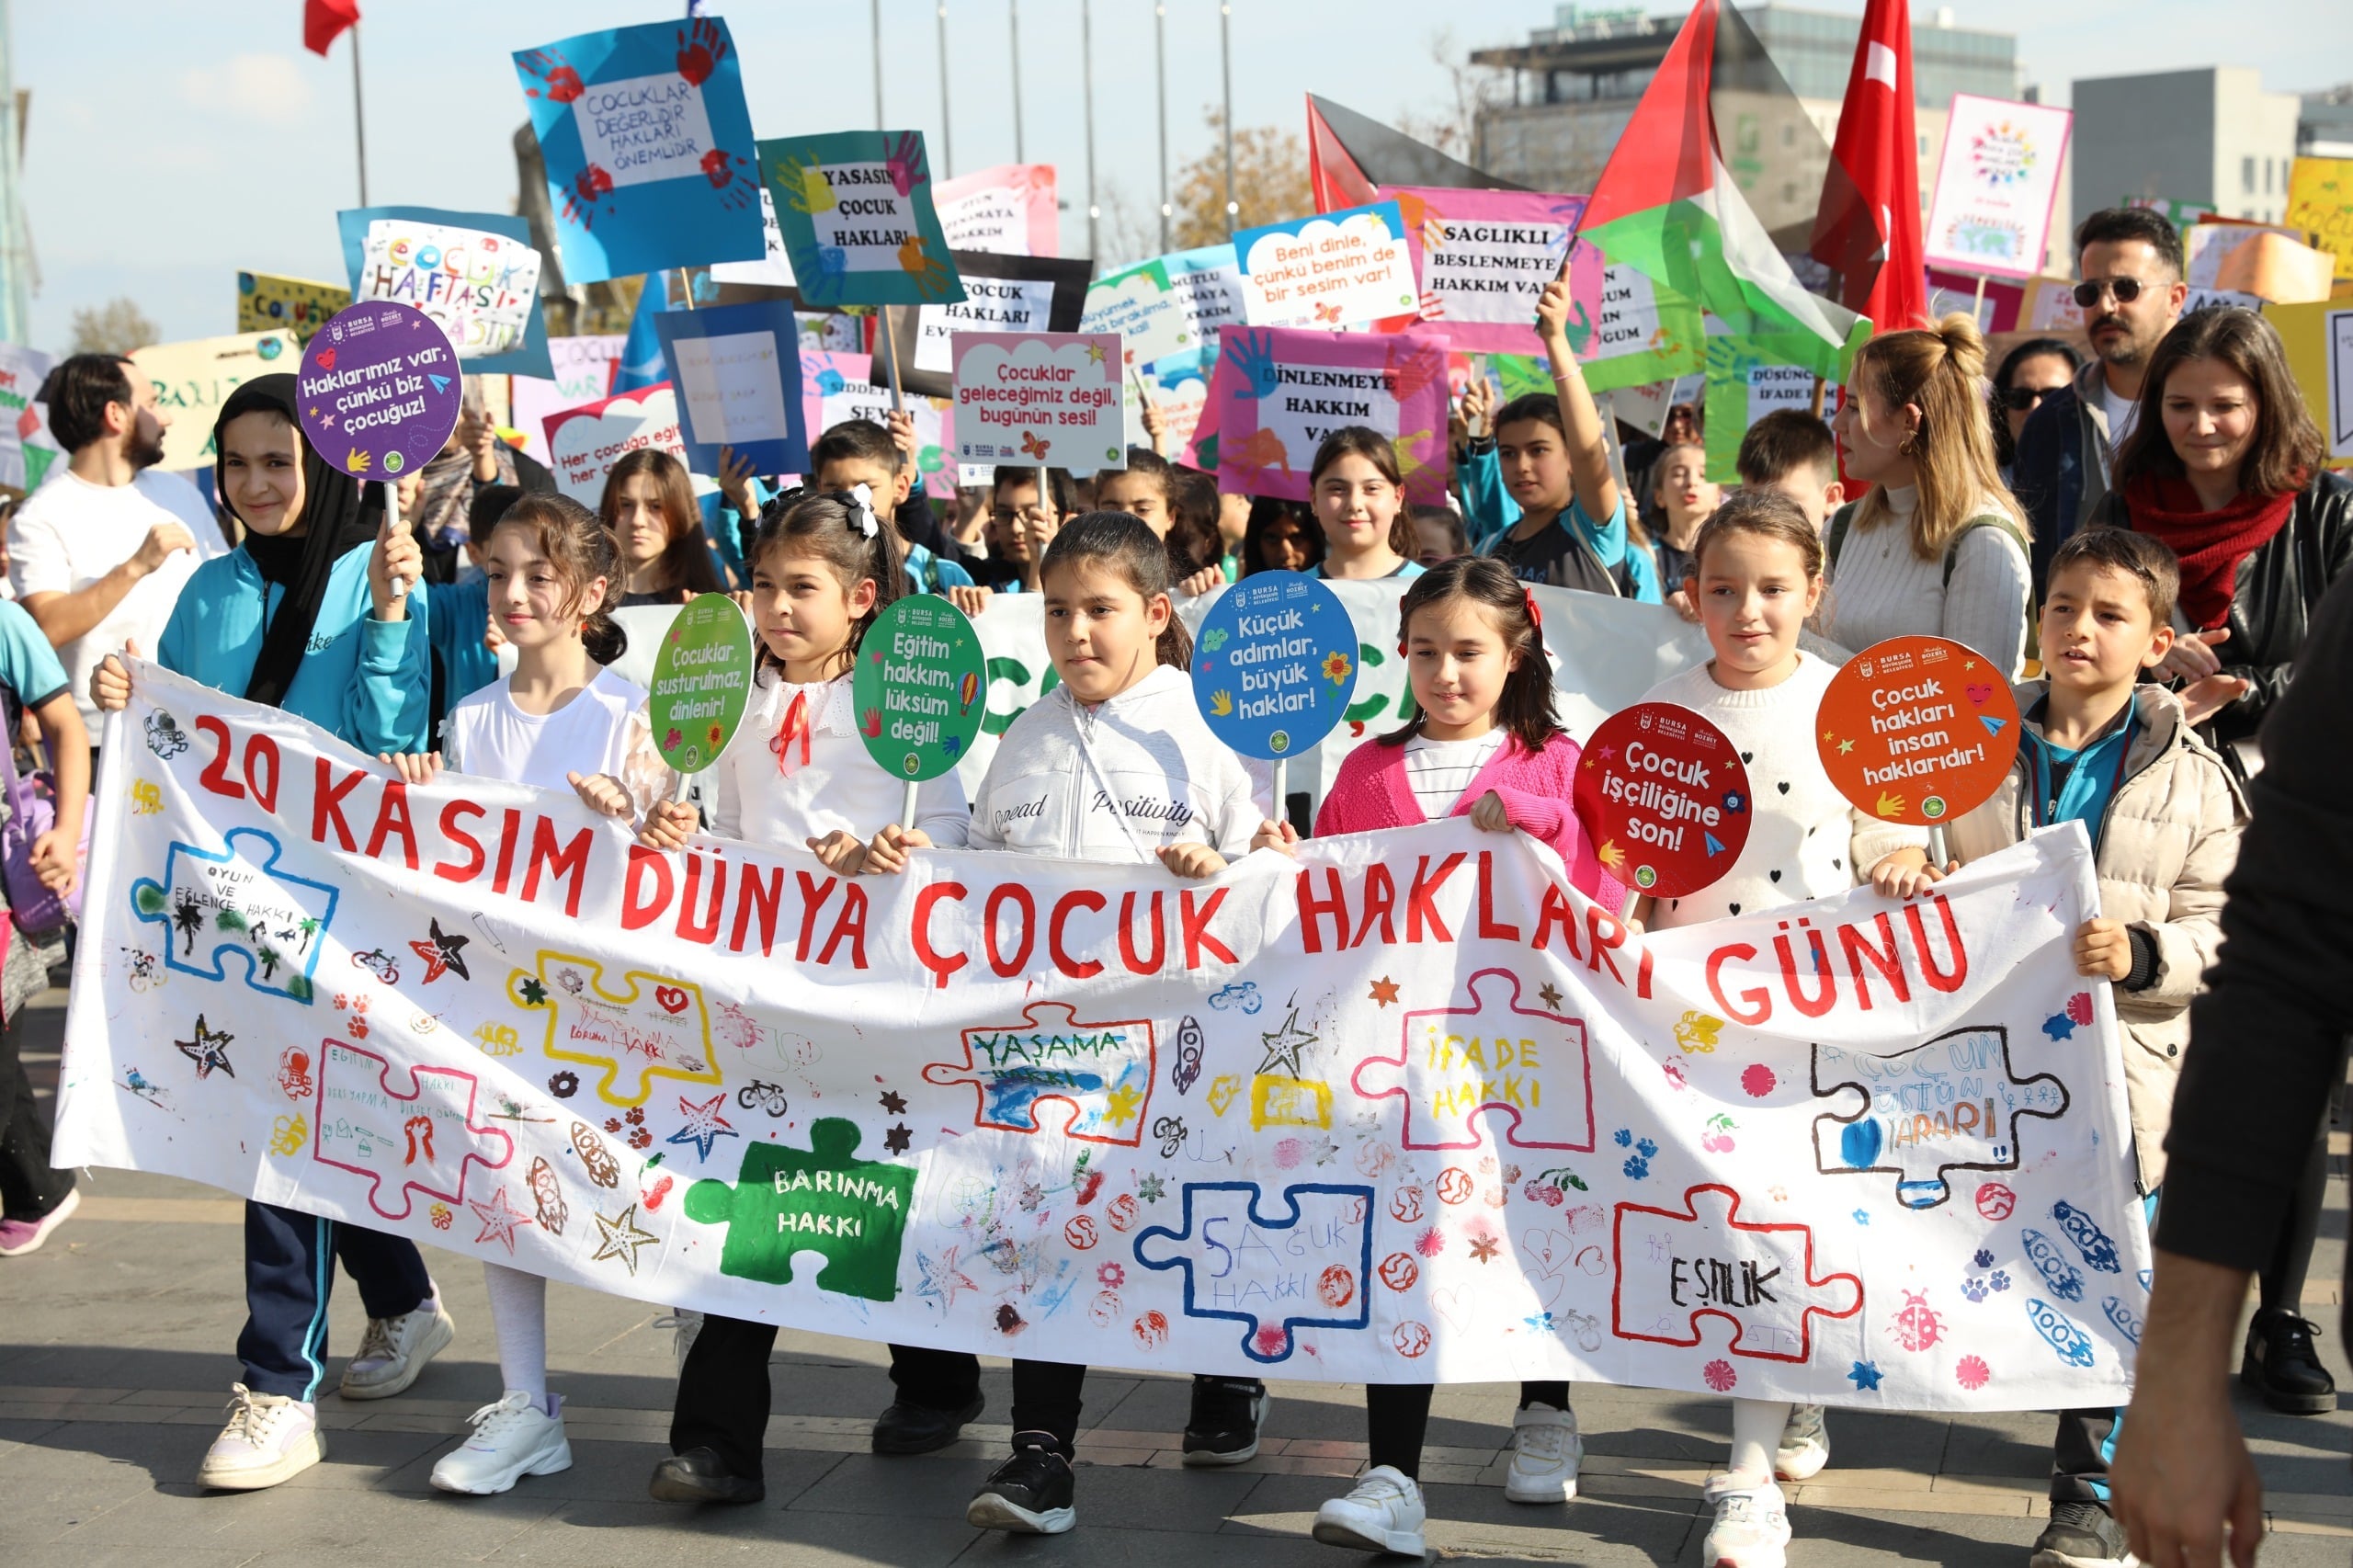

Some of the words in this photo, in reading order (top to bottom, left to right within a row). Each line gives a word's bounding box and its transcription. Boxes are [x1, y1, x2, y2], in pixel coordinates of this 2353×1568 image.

[838, 199, 897, 220] ÇOCUK
[833, 231, 911, 246] HAKLARI
[1276, 243, 1313, 262] Beni
[1320, 235, 1367, 253] dinle,
[1255, 265, 1306, 287] çünkü
[1312, 255, 1367, 274] benim
[1373, 248, 1395, 262] de
[1433, 255, 1556, 271] BESLENMEYE
[1172, 272, 1221, 288] MUTLU
[1265, 288, 1290, 303] bir
[1297, 277, 1348, 296] sesim
[1355, 266, 1392, 284] var!
[1433, 278, 1509, 293] HAKKIM
[347, 316, 373, 327] BURSA
[945, 305, 1030, 324] HAKLARI
[302, 357, 403, 397] Haklarımız
[407, 347, 447, 367] var,
[997, 363, 1075, 383] Çocuklar
[1263, 364, 1396, 391] DİNLENMEYE
[336, 382, 392, 414] çünkü
[395, 375, 424, 395] biz
[960, 385, 1063, 405] geleceğimiz
[1069, 387, 1117, 408] değil,
[1286, 397, 1370, 416] HAKKIM
[1759, 387, 1802, 400] İFADE
[344, 395, 426, 436] çocuğuz!
[980, 406, 1052, 426] bugünün
[1059, 409, 1097, 426] sesi!
[1304, 426, 1333, 442] VA
[561, 452, 588, 470] Her
[594, 436, 649, 460] çocuğa
[571, 468, 596, 484] her
[1252, 585, 1278, 596] BURSA
[912, 608, 933, 617] BURSA
[1238, 608, 1303, 638] Küçük
[672, 642, 734, 671] Çocuklar
[893, 632, 949, 660] Eğitim
[1230, 637, 1318, 666] adımlar,
[1880, 652, 1911, 664] BURSA
[656, 669, 744, 696] susturulmaz,
[883, 660, 955, 690] hakkım,
[1242, 663, 1309, 692] büyük
[885, 688, 949, 716] lüksüm
[1238, 687, 1315, 720] haklar!
[1871, 678, 1944, 711] Çocuk
[669, 696, 726, 721] dinlenir!
[1870, 703, 1955, 733] hakları
[891, 718, 939, 746] değil!
[1660, 717, 1687, 731] BURSA
[1887, 731, 1949, 756] insan
[1625, 741, 1711, 790] Çocuk
[1863, 743, 1985, 786] haklarıdır!
[1091, 790, 1194, 827] Positivity
[1602, 769, 1721, 827] işçiliğine
[1626, 817, 1684, 852] son!
[196, 714, 280, 814] 20
[312, 756, 595, 918] KASIM
[621, 844, 869, 970] DÜNYA
[911, 881, 1239, 990] ÇOCUK
[1295, 849, 1653, 999] HAKLARI
[1705, 890, 1968, 1027] GÜNÜ
[209, 867, 254, 884] OYUN
[216, 883, 236, 897] VE
[246, 903, 293, 923] HAKKI
[972, 1032, 1120, 1067] YAŞAMA
[1427, 1026, 1541, 1072] İFADE
[421, 1075, 454, 1091] HAKKI
[1433, 1073, 1540, 1119] HAKKI
[774, 1169, 899, 1210] BARINMA
[779, 1212, 861, 1238] HAKKI
[1212, 1272, 1307, 1308] HAKKI
